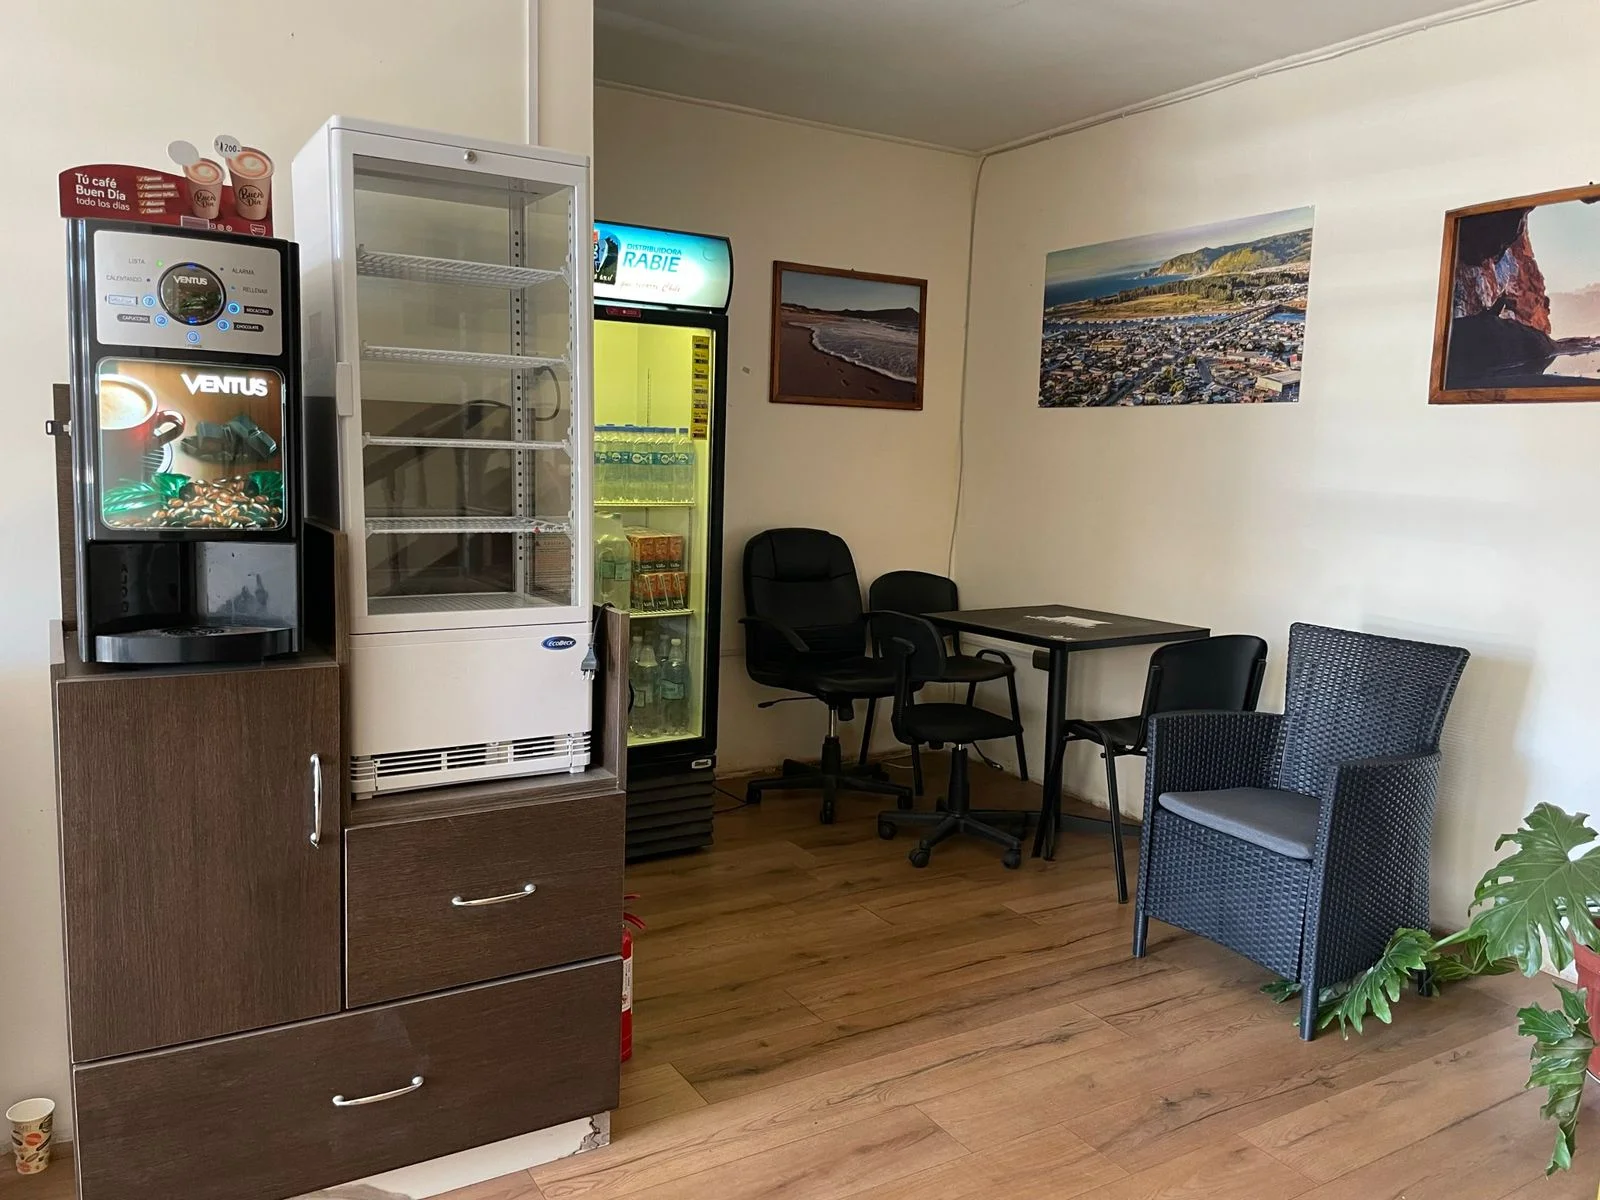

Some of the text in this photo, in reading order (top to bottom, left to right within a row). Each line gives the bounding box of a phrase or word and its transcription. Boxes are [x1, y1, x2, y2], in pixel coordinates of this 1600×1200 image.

[75, 172, 117, 189] Tú café
[76, 184, 126, 201] Buen Día
[76, 196, 96, 207] todo
[98, 199, 111, 209] los
[626, 243, 682, 256] DISTRIBUIDORA
[622, 251, 681, 273] RABIE
[232, 267, 255, 275] ALARMA
[173, 275, 208, 286] VENTUS
[243, 286, 268, 294] RELLENAR
[180, 373, 269, 397] VENTUS
